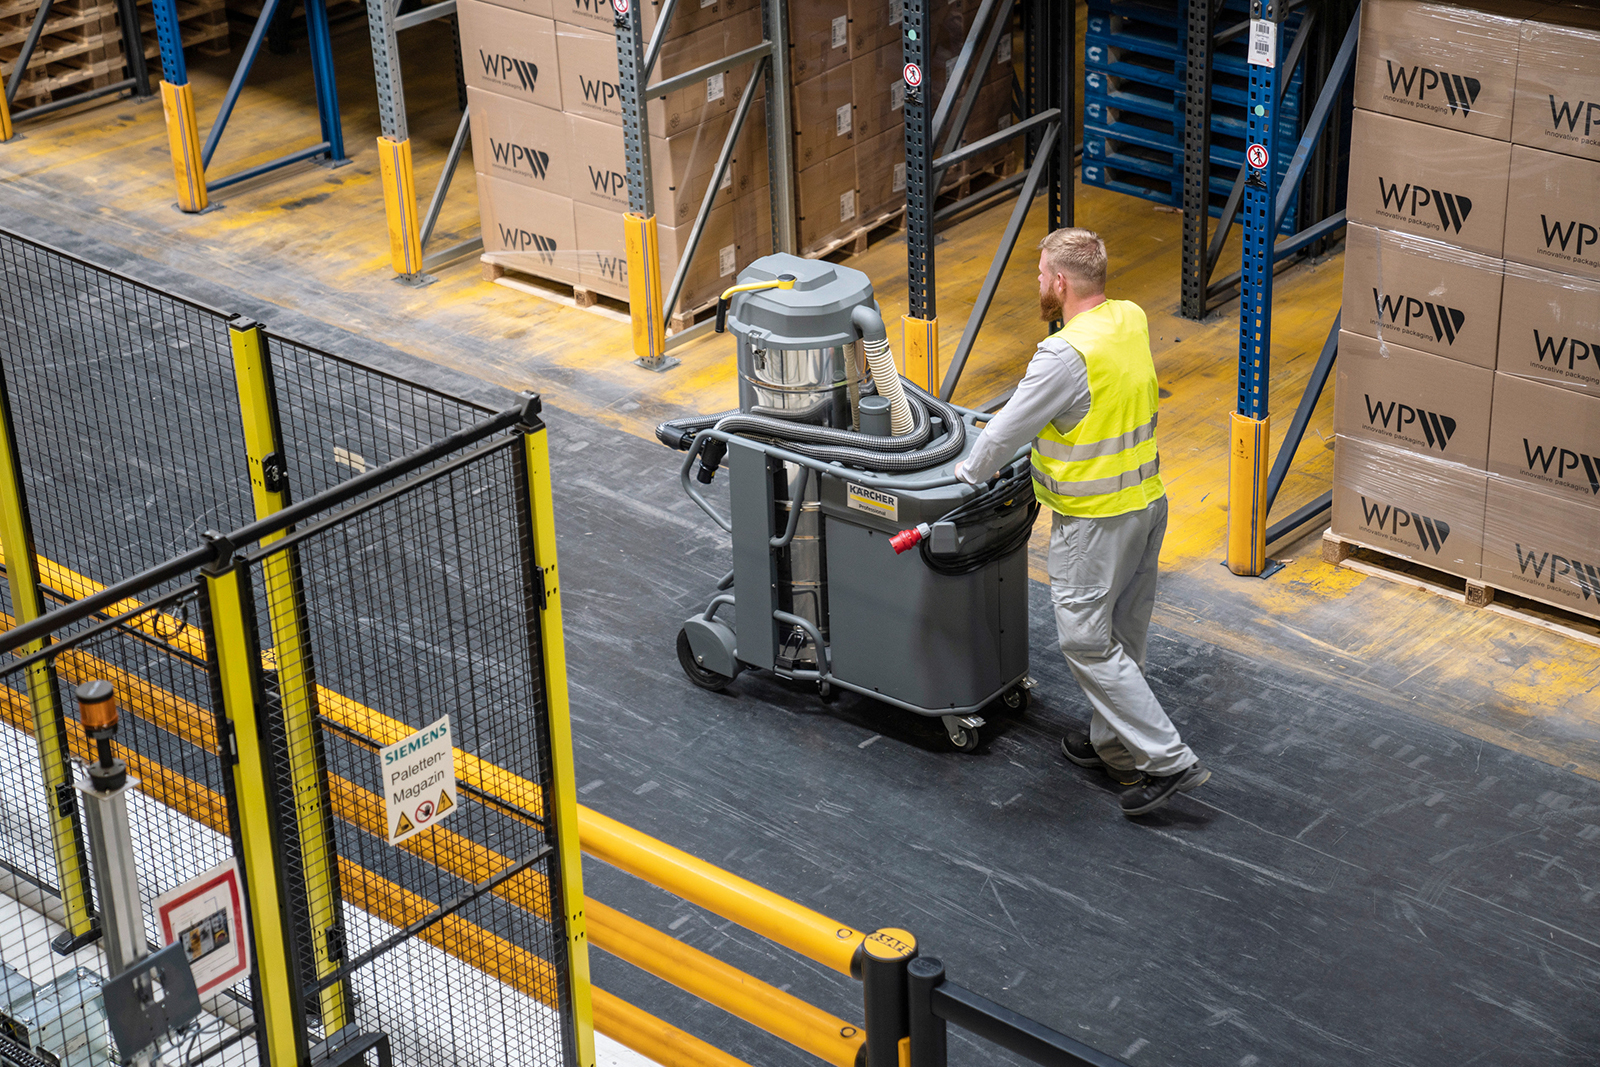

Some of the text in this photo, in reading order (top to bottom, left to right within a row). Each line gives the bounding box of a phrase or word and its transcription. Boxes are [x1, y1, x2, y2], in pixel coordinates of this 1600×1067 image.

[850, 485, 894, 505] KÄRCHER
[859, 504, 886, 515] Professional
[385, 723, 446, 765] SIEMENS
[390, 751, 446, 786] Paletten-
[393, 769, 445, 805] Magazin
